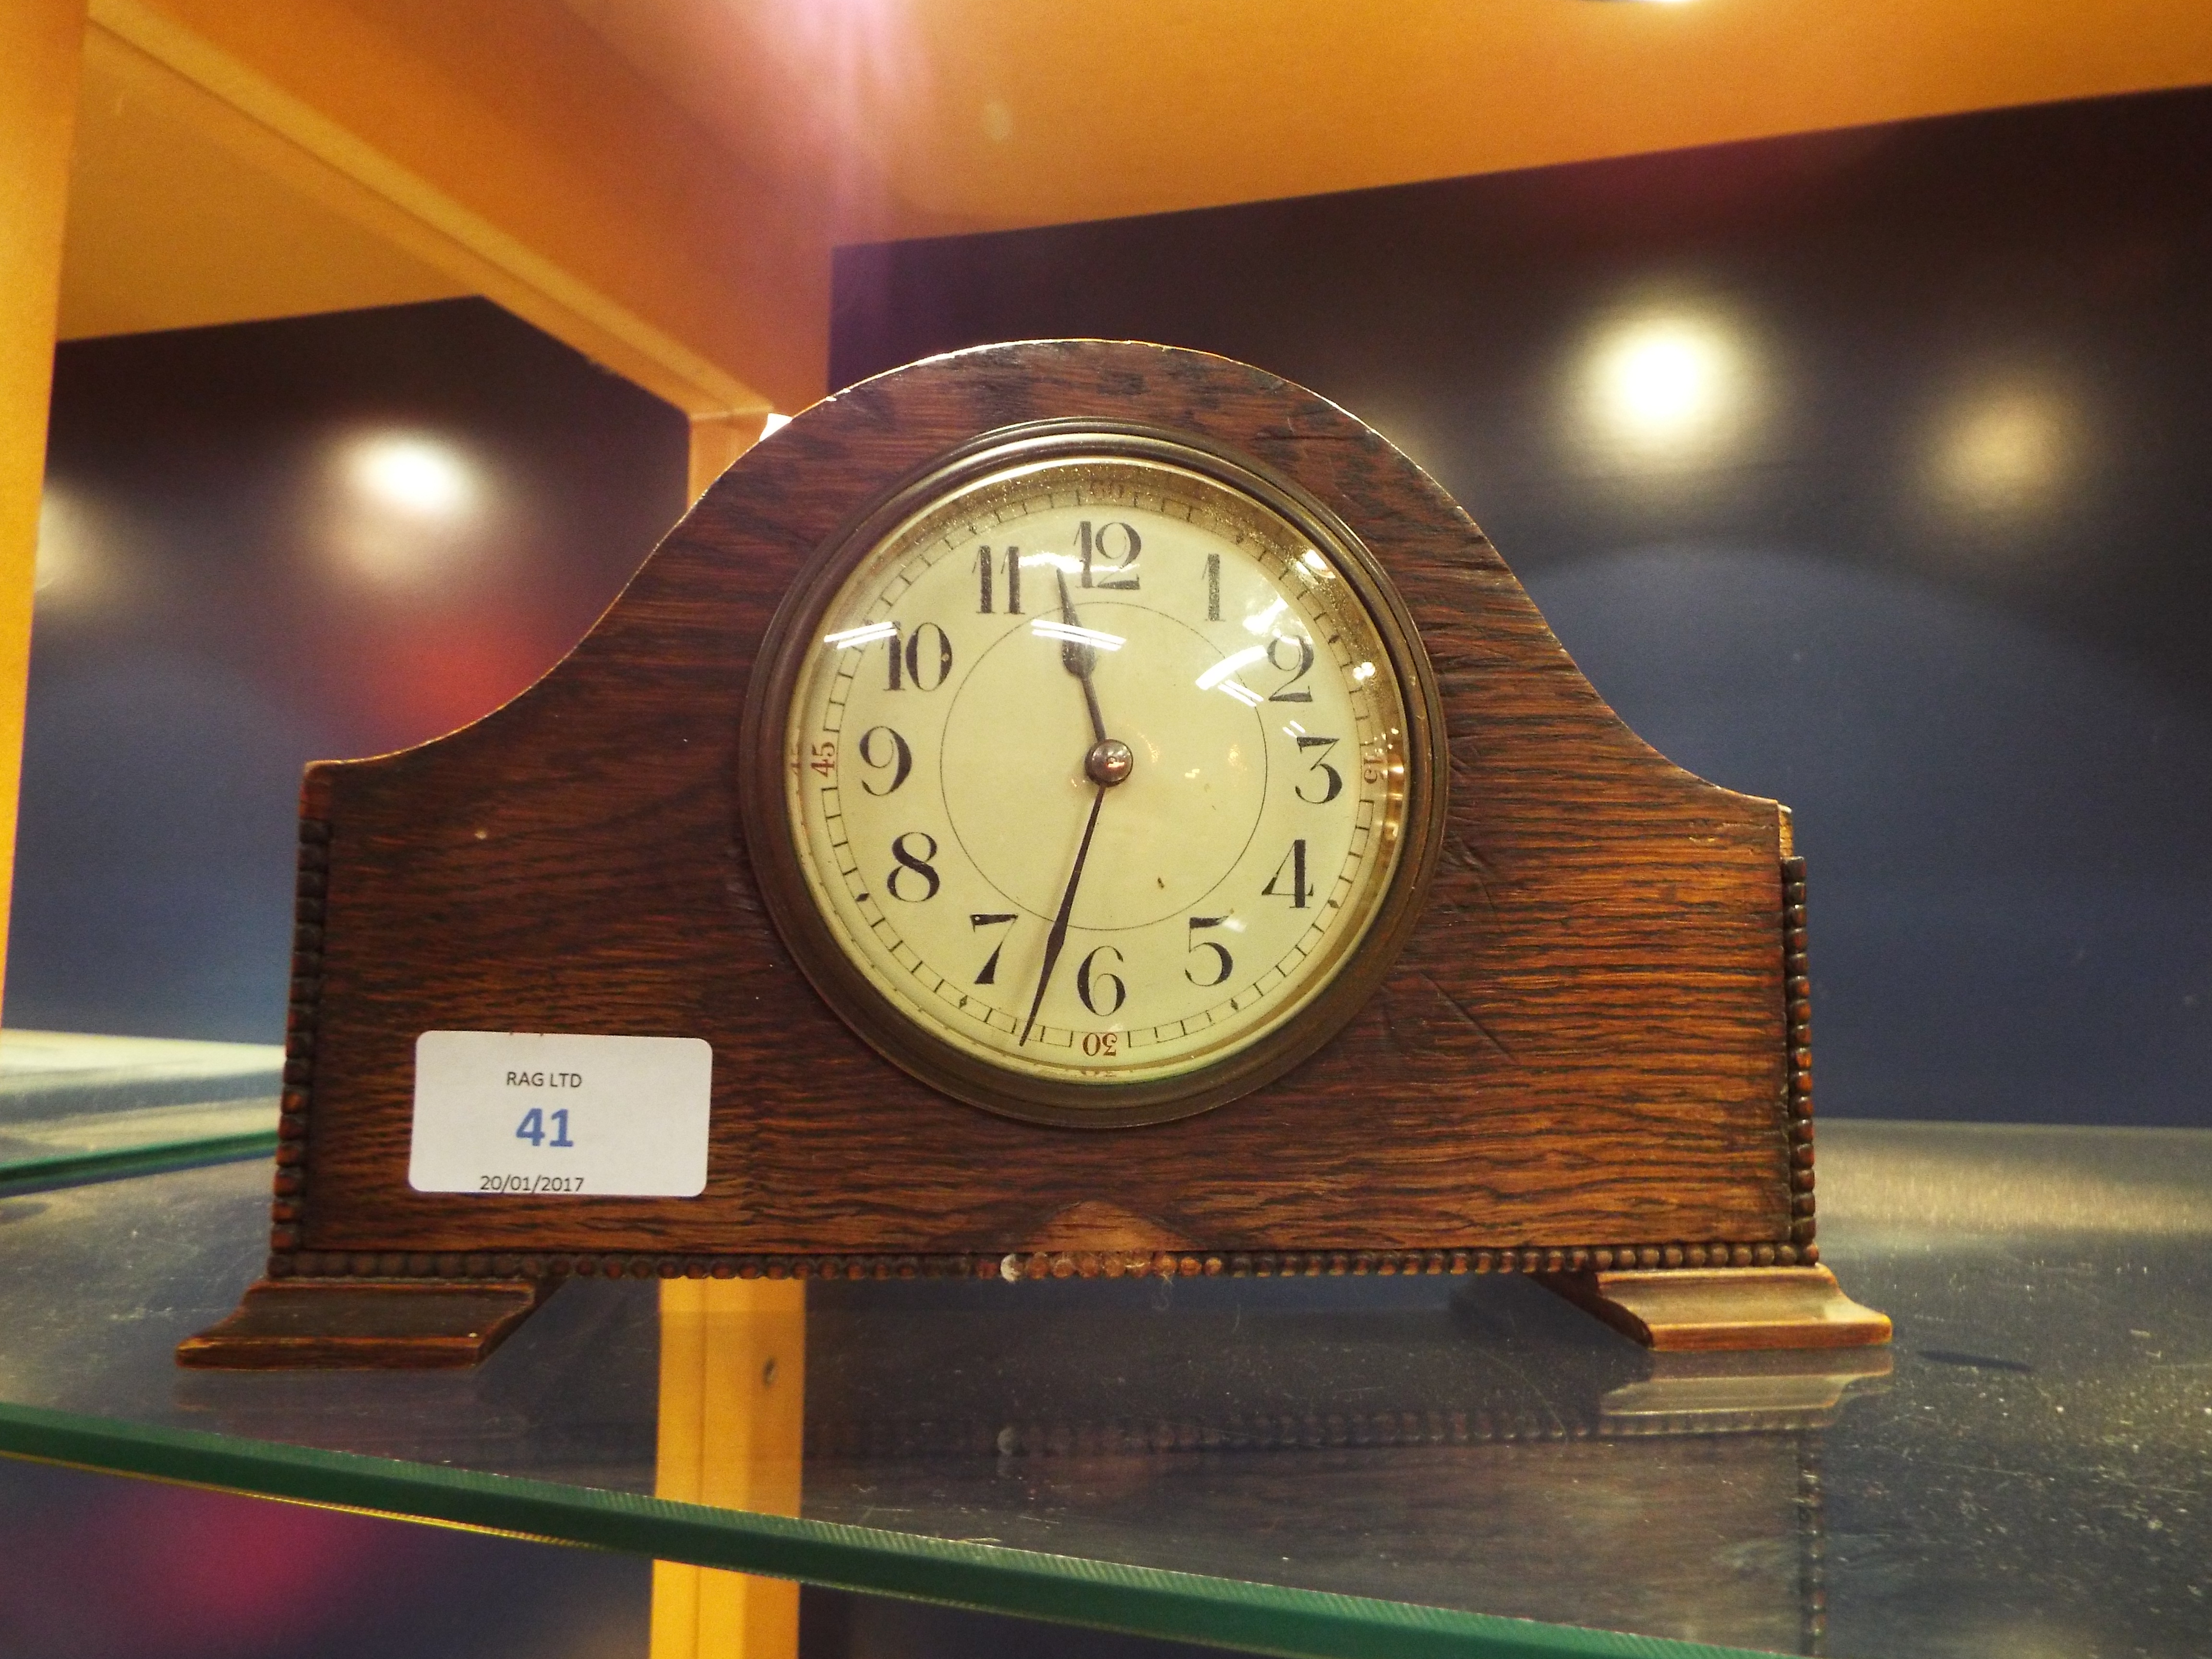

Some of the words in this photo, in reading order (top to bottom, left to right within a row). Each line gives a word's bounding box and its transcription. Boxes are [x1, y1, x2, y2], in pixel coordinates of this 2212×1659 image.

[972, 545, 1025, 614] 11
[1073, 521, 1142, 590] 12
[1202, 553, 1226, 622] 1
[881, 622, 953, 692] 10
[1267, 635, 1314, 702] 2
[811, 742, 835, 777] 45
[859, 726, 912, 796] 9
[1295, 736, 1343, 804] 3
[887, 832, 940, 902] 8
[1262, 839, 1313, 908] 4
[970, 914, 1018, 984] 7
[1077, 946, 1126, 1016] 6
[1185, 914, 1233, 986] 5
[507, 1071, 544, 1086] RAG
[551, 1073, 582, 1088] LTD
[1082, 1033, 1118, 1057] 30
[515, 1107, 574, 1147] 41
[480, 1174, 584, 1193] 20/01/2017
